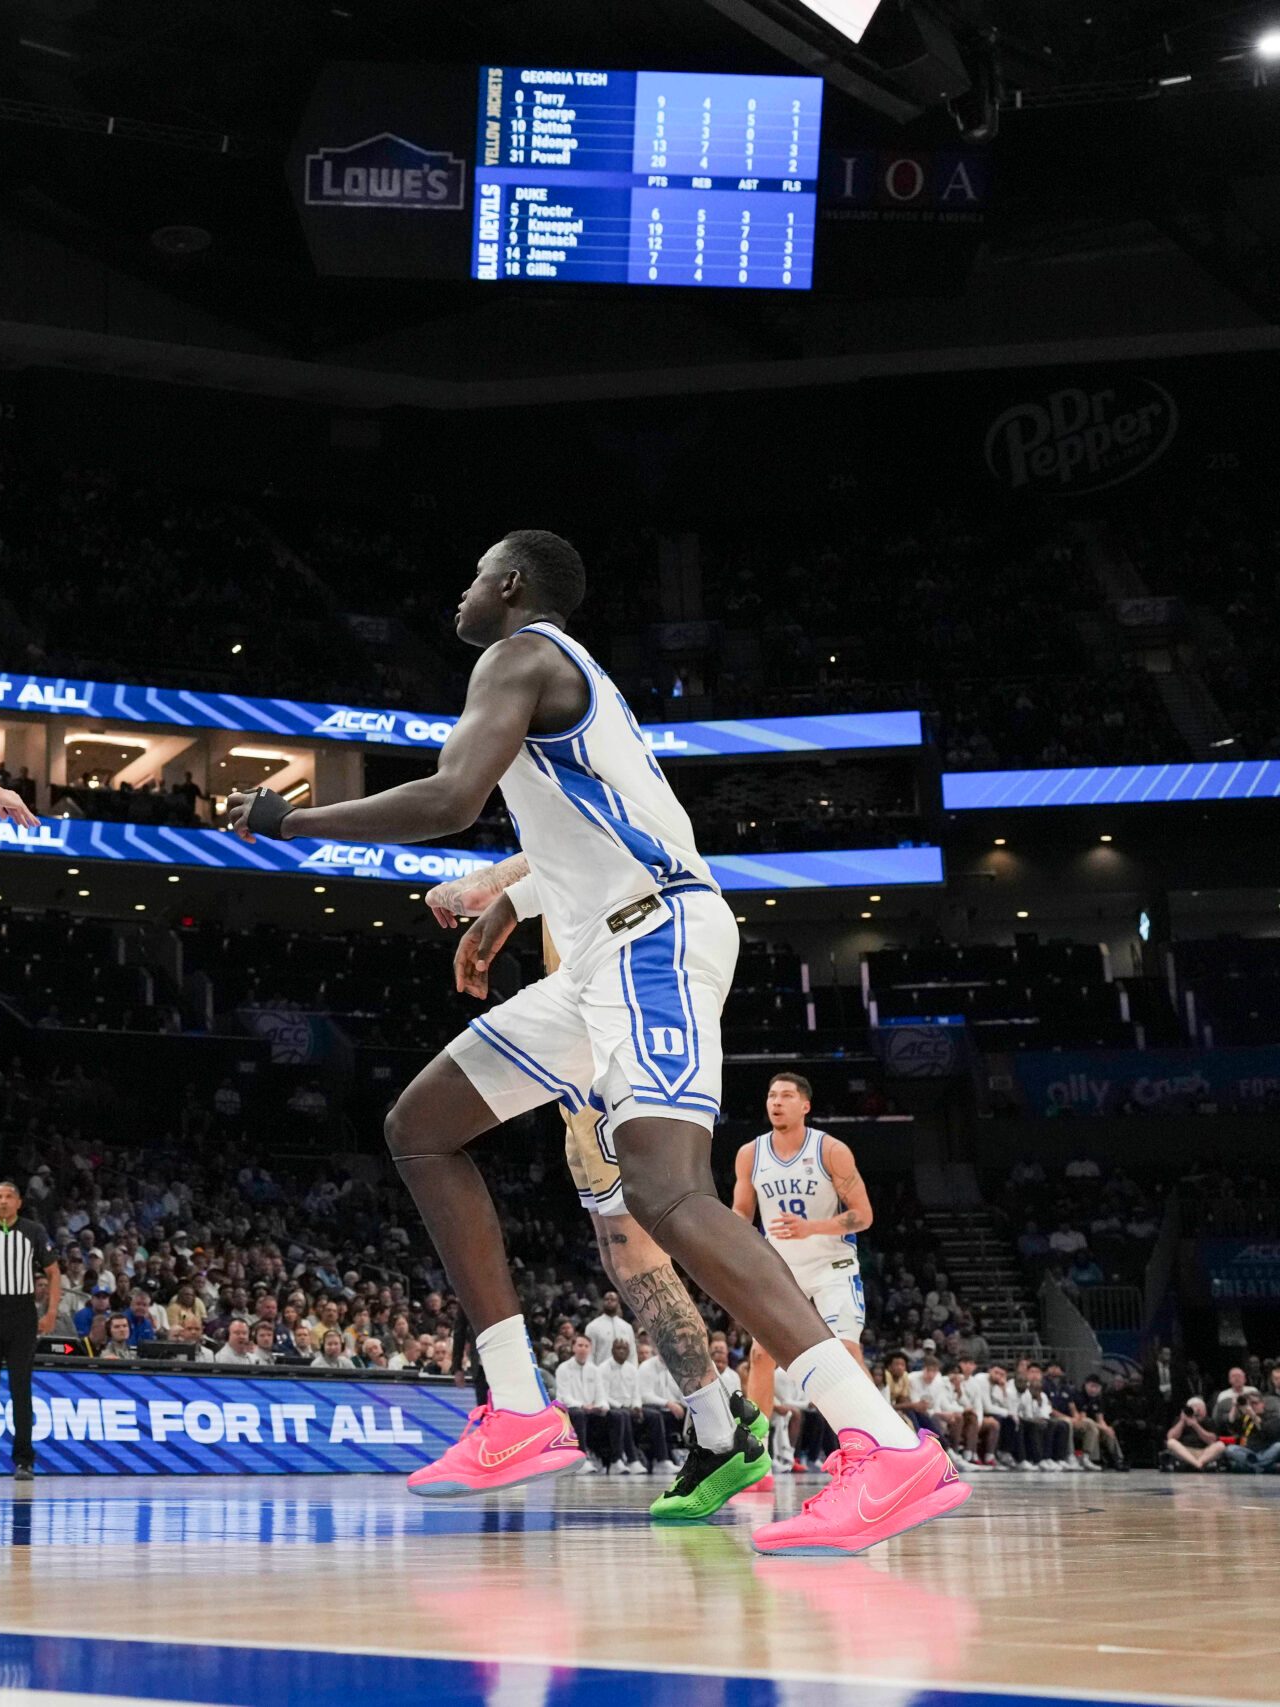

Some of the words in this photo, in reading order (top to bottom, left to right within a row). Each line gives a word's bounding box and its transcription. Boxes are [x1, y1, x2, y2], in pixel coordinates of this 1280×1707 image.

[521, 70, 574, 85] GEORGIA
[575, 72, 608, 86] TECH
[515, 90, 524, 103] 0
[534, 90, 566, 107] Terry
[703, 97, 712, 110] 4
[747, 98, 757, 111] 0
[792, 99, 801, 113] 2
[516, 106, 523, 118] 1
[533, 106, 576, 122] George
[702, 112, 711, 125] 3
[747, 113, 756, 127] 5
[792, 115, 800, 128] 1
[511, 120, 526, 133] 10
[532, 120, 571, 135] Sutton
[701, 126, 710, 139] 3
[746, 128, 755, 141] 0
[791, 130, 799, 142] 1
[485, 121, 500, 166] YELLOW
[511, 134, 525, 148] 11
[531, 134, 578, 150] Ndongo
[652, 139, 667, 153] 13
[701, 141, 709, 154] 7
[509, 149, 524, 163] 31
[531, 150, 571, 165] Powell
[699, 156, 708, 170] 4
[745, 158, 753, 171] 1
[788, 159, 797, 173] 2
[322, 160, 449, 200] LOWE'S
[648, 176, 668, 188] PTS
[738, 179, 759, 191] AST
[782, 180, 802, 192] FLS
[515, 188, 548, 201] DUKE
[479, 184, 501, 241] DEVILS
[510, 203, 519, 216] 5
[528, 203, 573, 217] Proctor
[651, 207, 660, 221] 6
[697, 209, 706, 222] 5
[741, 211, 750, 224] 3
[787, 212, 794, 226] 1
[510, 218, 519, 230] 7
[648, 223, 664, 236] 19
[696, 224, 705, 238] 5
[740, 226, 750, 239] 7
[786, 227, 793, 240] 1
[509, 232, 518, 245] 9
[647, 237, 663, 250] 12
[740, 240, 749, 253] 0
[477, 242, 499, 280] BLUE
[505, 247, 520, 260] 14
[526, 247, 566, 261] James
[650, 251, 659, 265] 7
[694, 253, 703, 266] 4
[739, 254, 748, 268] 3
[648, 267, 658, 280] 0
[694, 268, 703, 282] 4
[738, 270, 747, 283] 0
[783, 271, 792, 285] 0
[1050, 388, 1115, 437] Dr
[1007, 401, 1162, 488] Pepper
[16, 683, 89, 709] ALL
[322, 710, 396, 732] ACCN
[405, 720, 457, 743] CO
[643, 731, 687, 750] LL
[308, 844, 385, 867] ACCN
[648, 1027, 685, 1056] D
[761, 1179, 818, 1199] DUKE
[149, 1400, 263, 1444] FOR
[269, 1404, 317, 1444] IT
[329, 1406, 423, 1444] ALL
